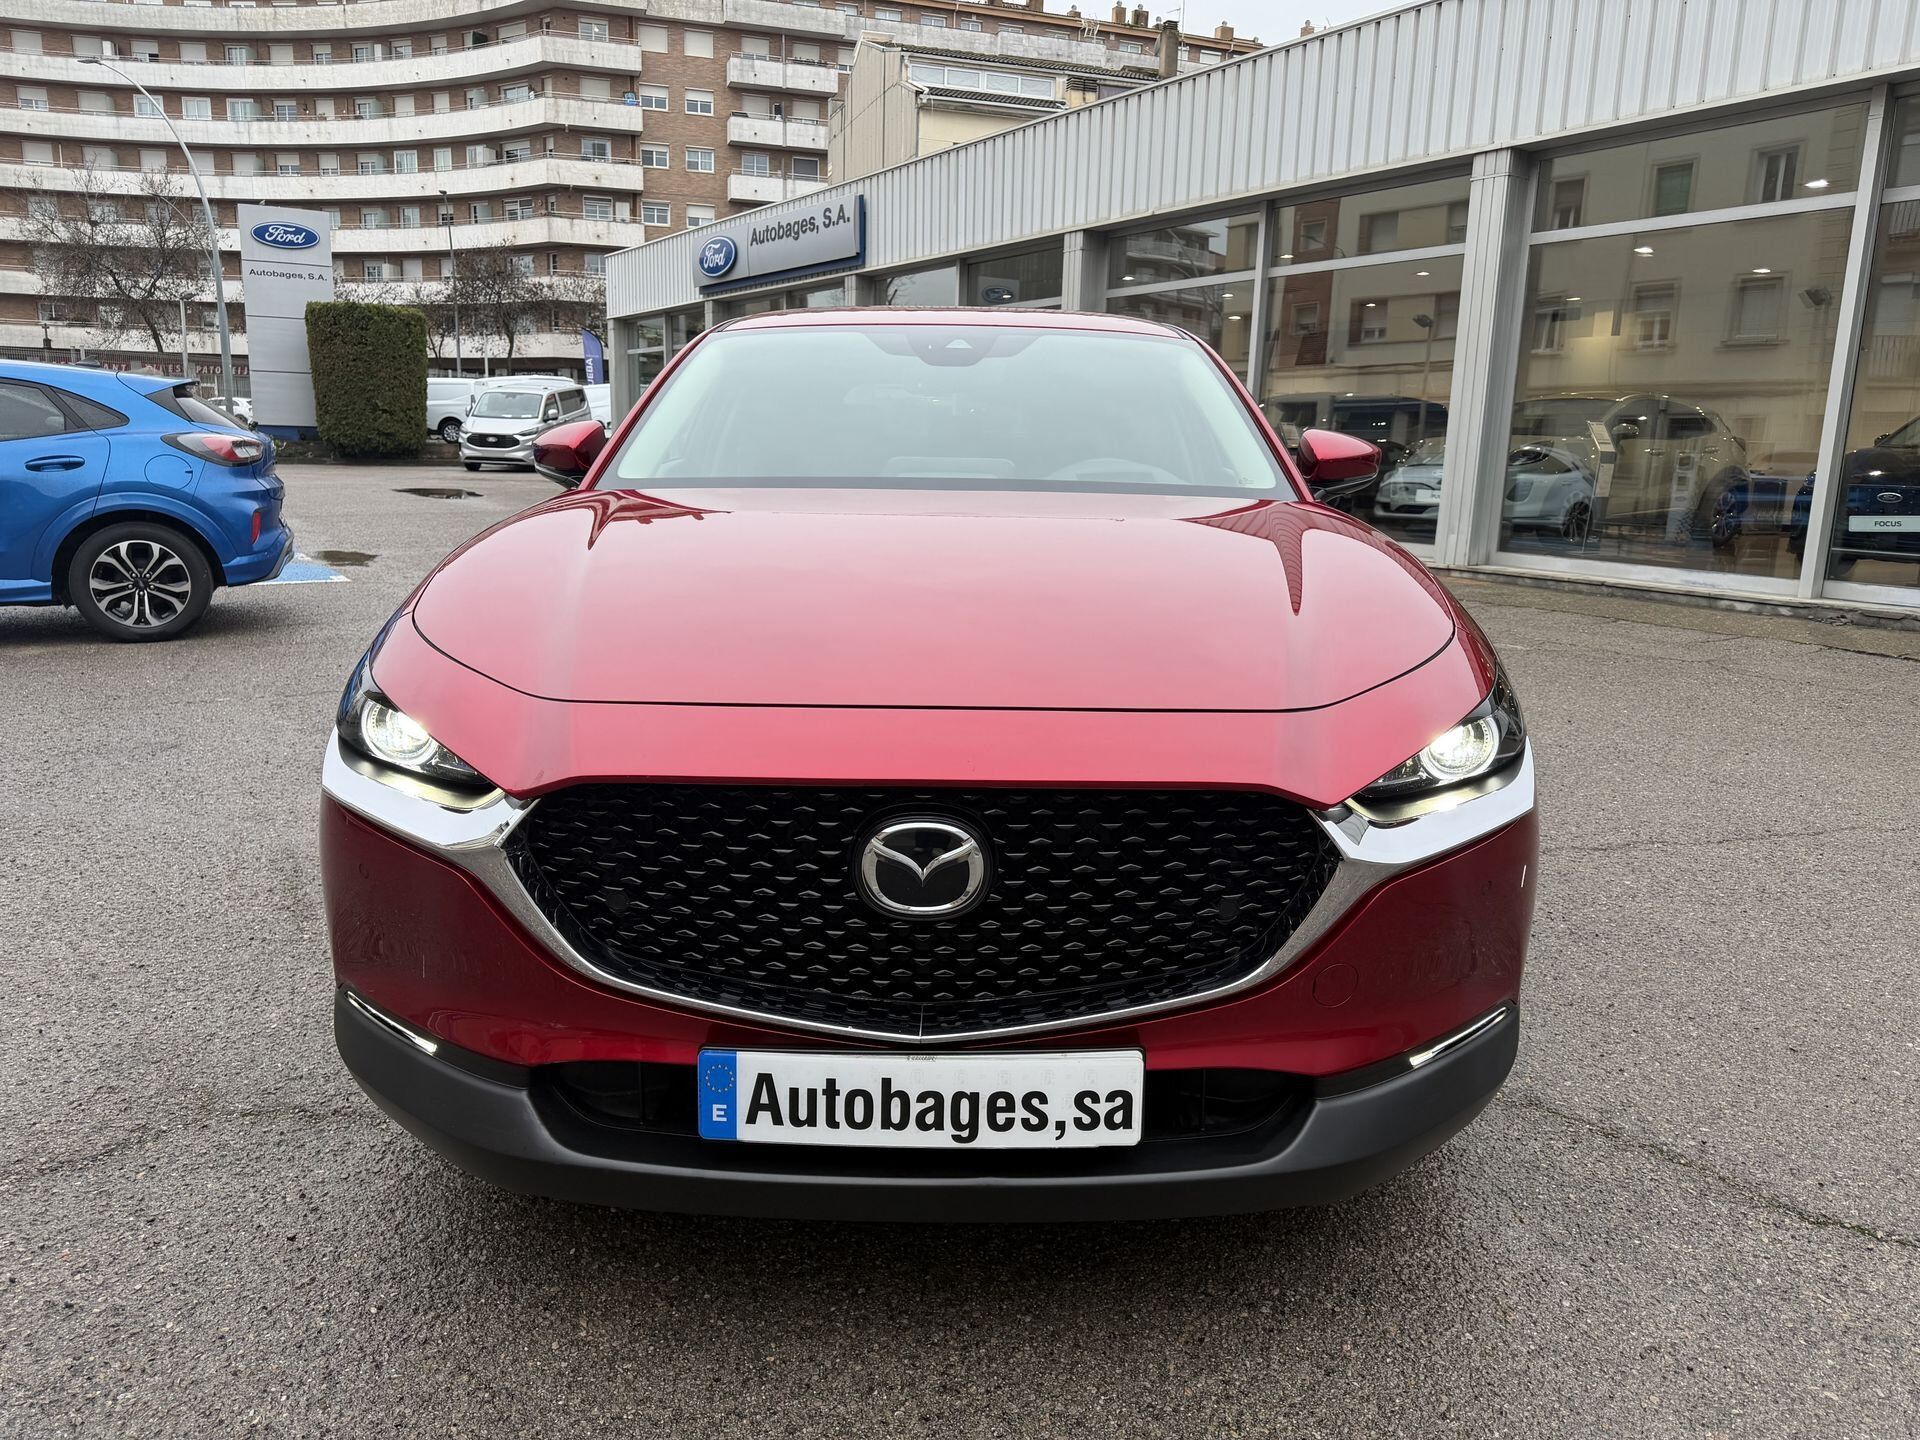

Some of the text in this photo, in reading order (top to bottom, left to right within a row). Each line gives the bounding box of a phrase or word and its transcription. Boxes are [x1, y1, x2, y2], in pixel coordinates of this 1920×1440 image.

[264, 225, 306, 244] Ford
[750, 204, 850, 247] Autobages, S.A.
[703, 243, 727, 269] Ford
[249, 268, 328, 281] Autobages, S.A.
[712, 1104, 727, 1122] E
[745, 1072, 1133, 1144] Autobages,sa
